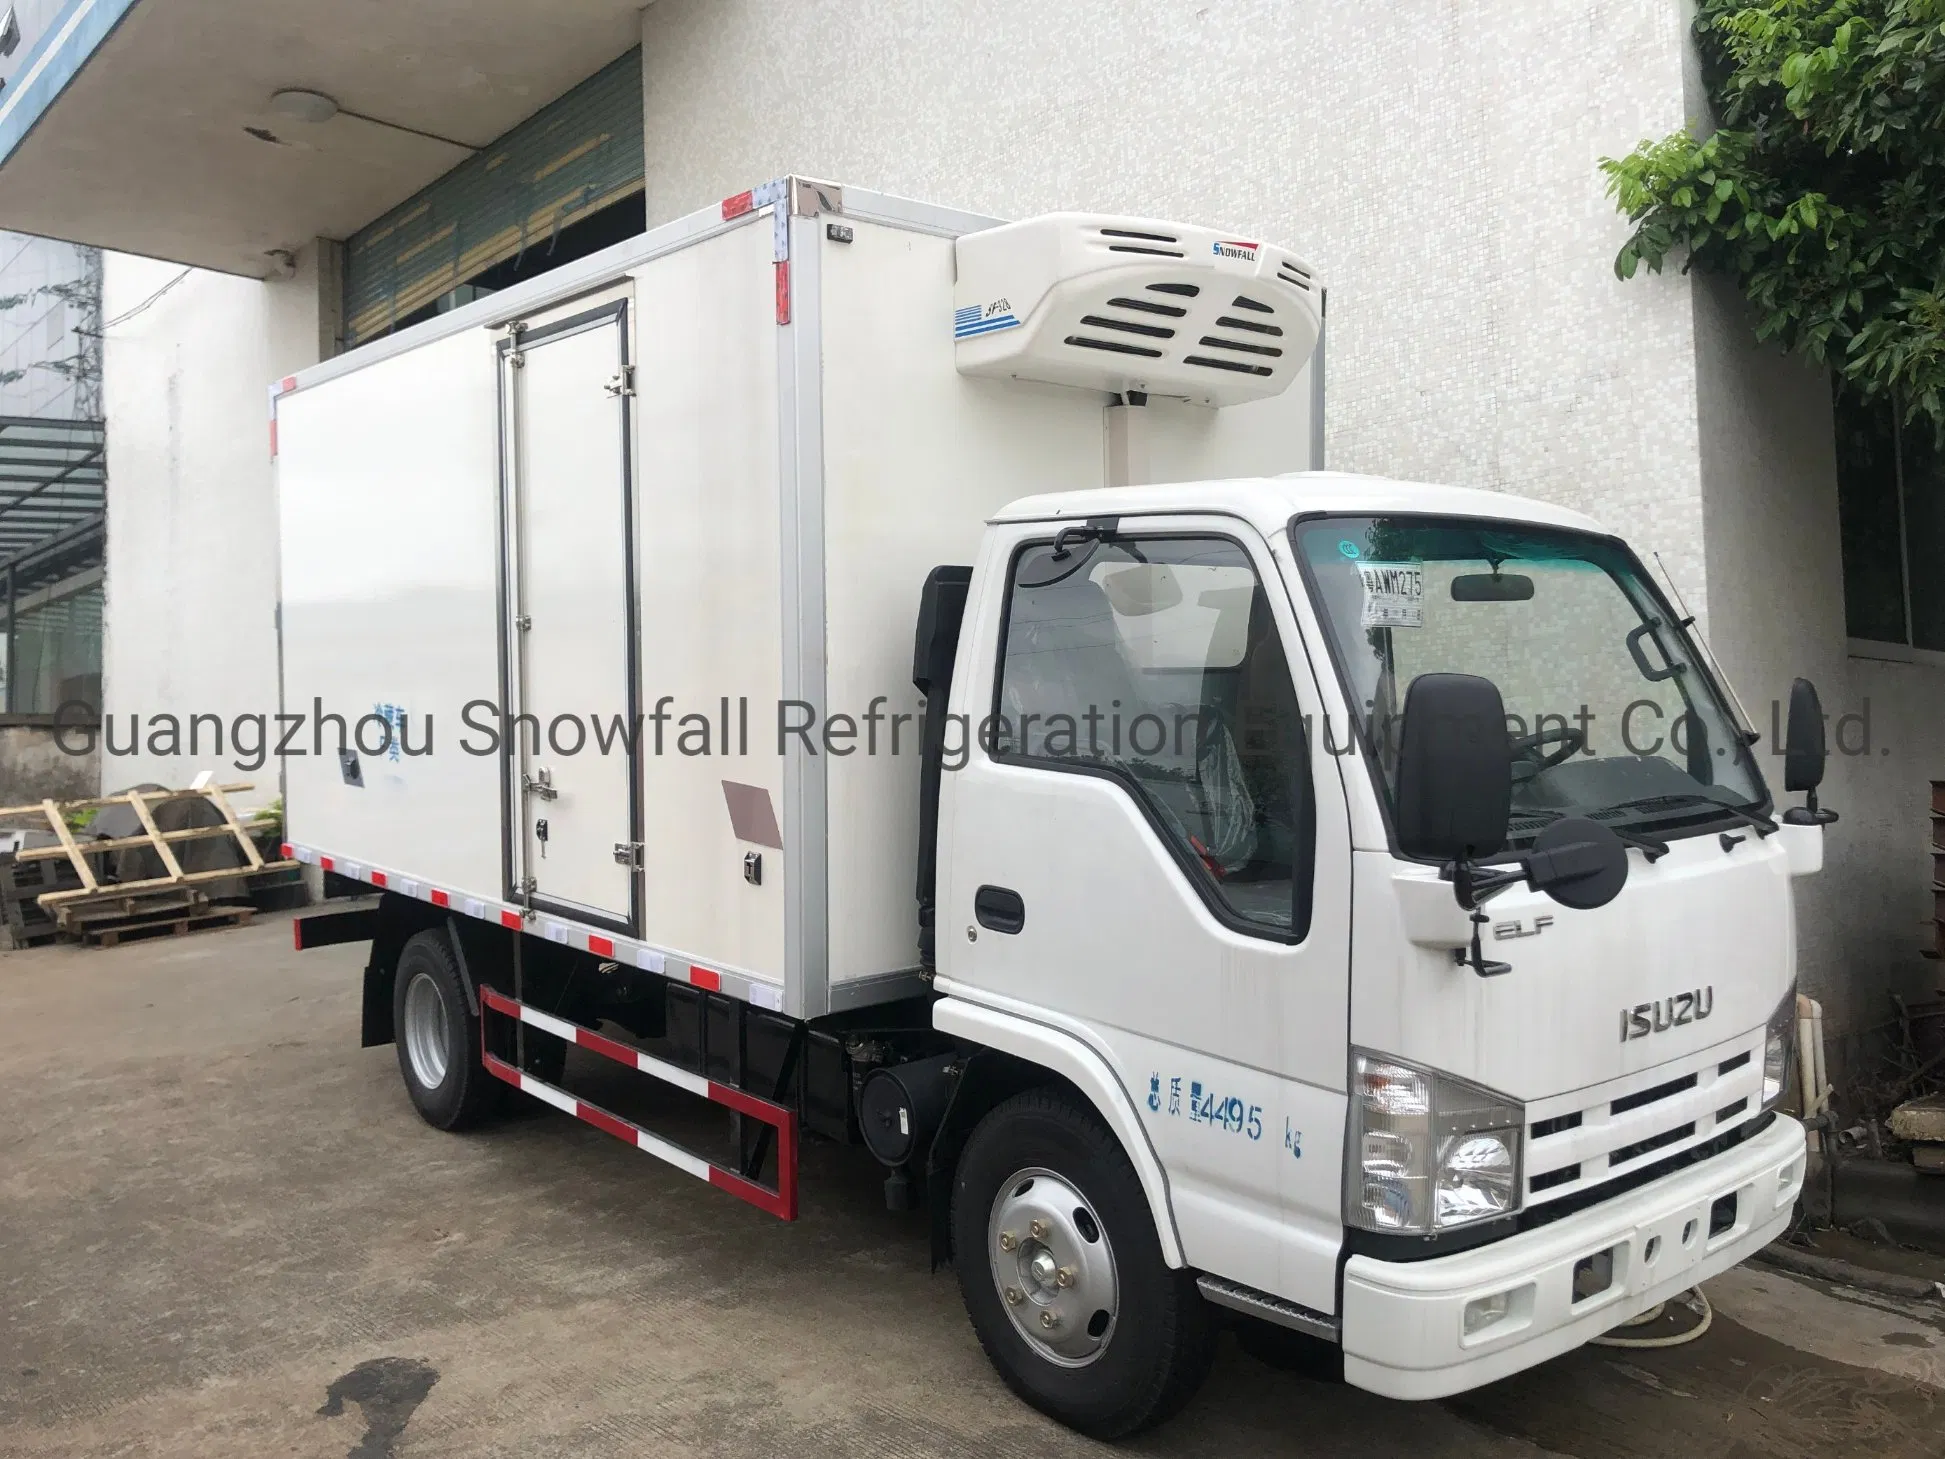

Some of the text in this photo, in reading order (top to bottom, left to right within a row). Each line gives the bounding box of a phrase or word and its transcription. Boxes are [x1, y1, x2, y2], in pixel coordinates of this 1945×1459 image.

[1213, 242, 1256, 262] SNOWFALL
[1493, 915, 1554, 940] ELF
[1619, 985, 1713, 1043] ISUZU
[1284, 1115, 1302, 1159] kg
